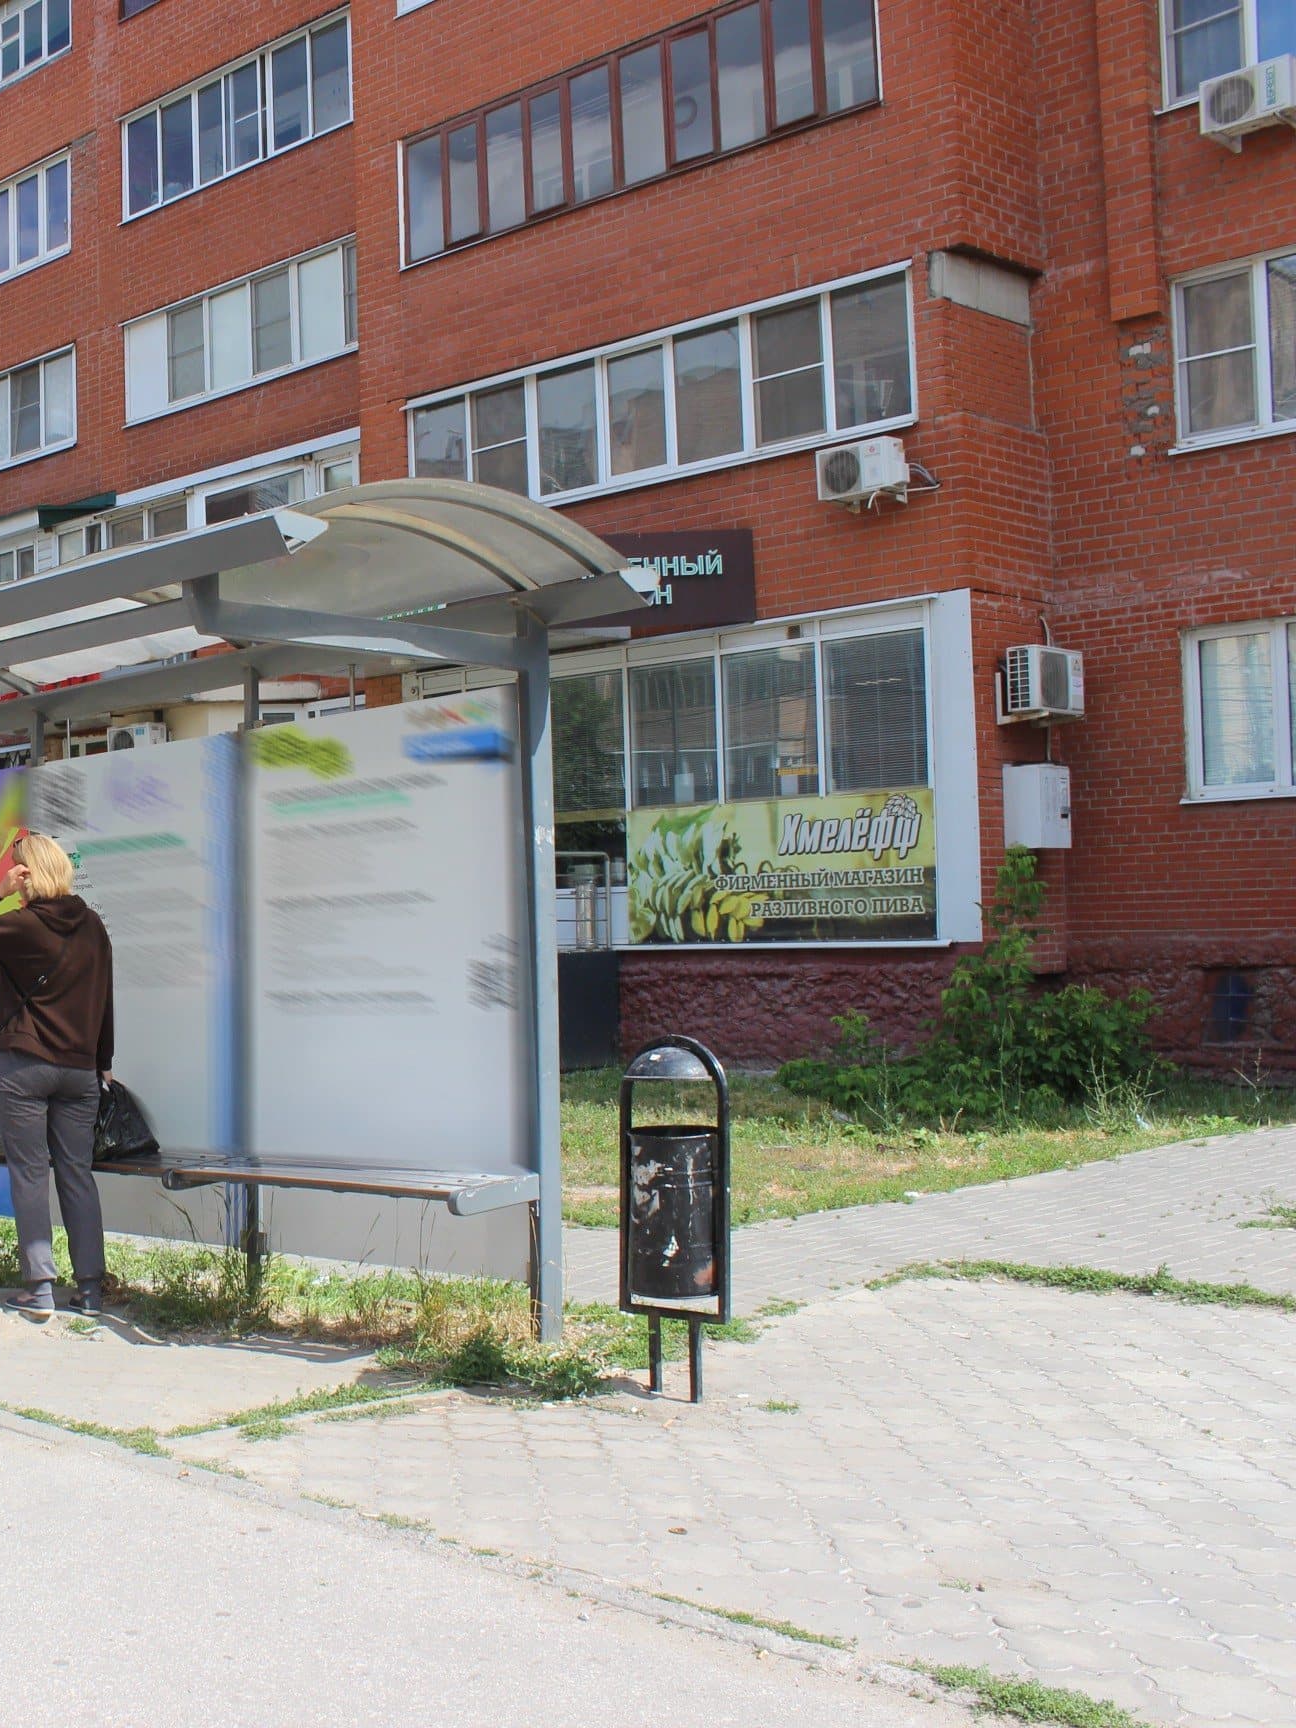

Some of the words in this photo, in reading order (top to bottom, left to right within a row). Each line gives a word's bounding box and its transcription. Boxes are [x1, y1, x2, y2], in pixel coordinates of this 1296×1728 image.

[778, 807, 922, 861] Хмелёфф
[715, 868, 831, 891] ФИРМЕННЫЙ
[833, 867, 924, 888] МАГАЗИН
[750, 898, 869, 918] РАЗЛИВНОГО
[871, 896, 925, 915] ПИВА
